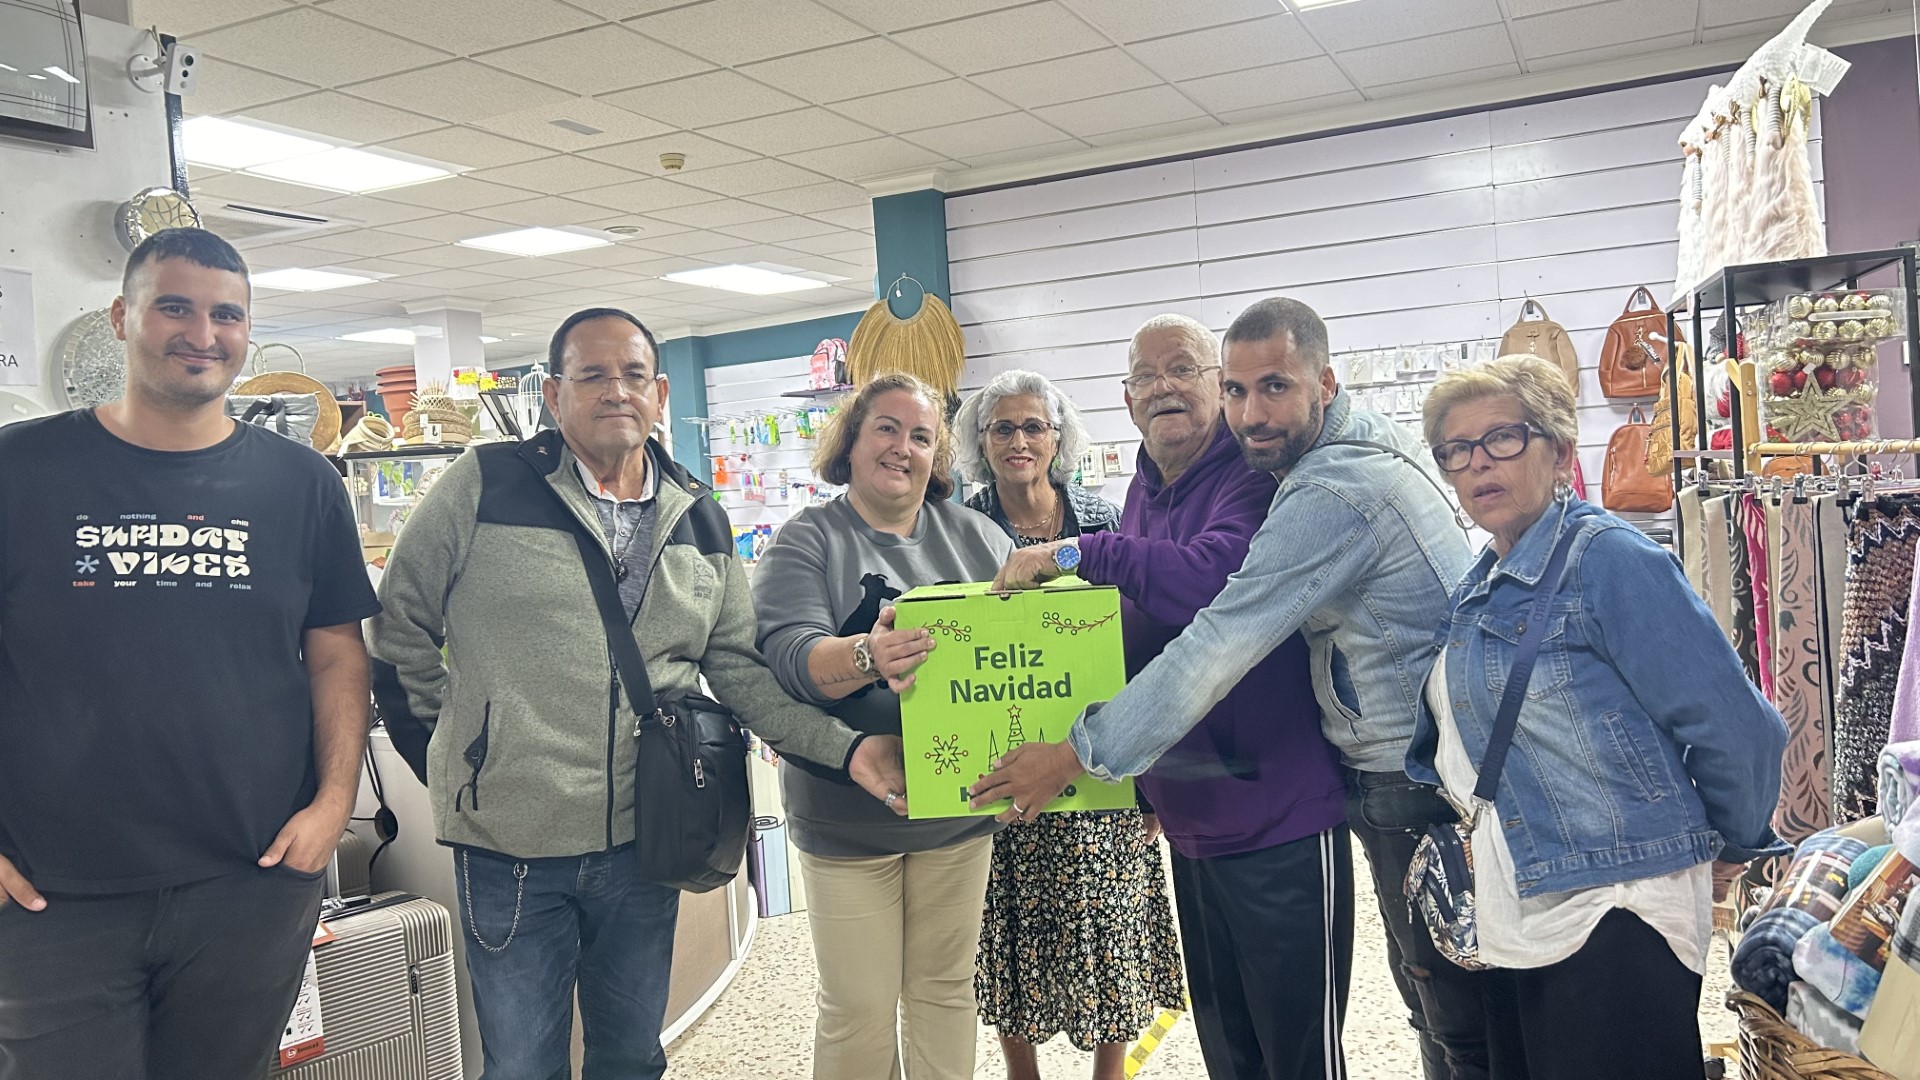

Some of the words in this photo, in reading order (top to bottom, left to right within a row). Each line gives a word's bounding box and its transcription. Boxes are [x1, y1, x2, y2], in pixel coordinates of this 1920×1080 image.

[120, 513, 157, 521] nothing
[230, 518, 249, 527] chill
[76, 525, 249, 552] SUNDAY
[106, 551, 251, 578] VIBES
[113, 580, 137, 588] your
[974, 643, 1044, 670] Feliz
[950, 672, 1072, 703] Navidad
